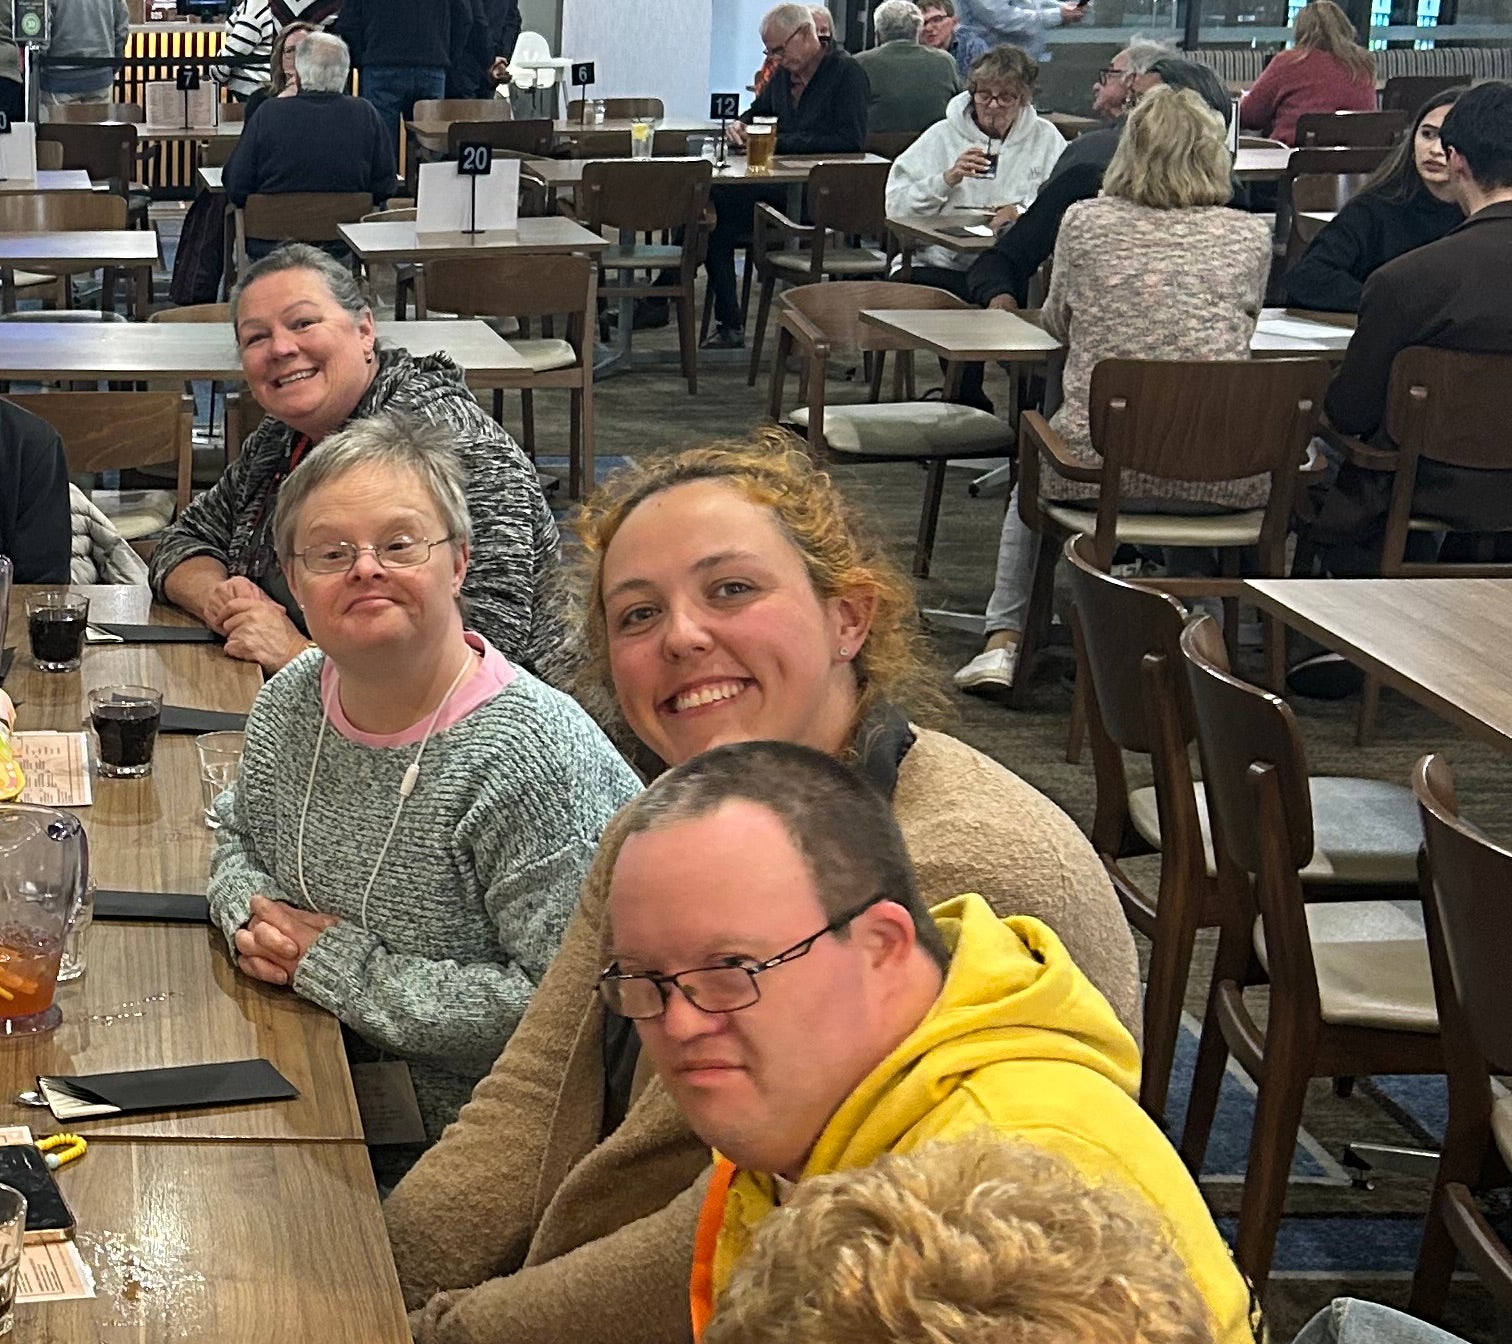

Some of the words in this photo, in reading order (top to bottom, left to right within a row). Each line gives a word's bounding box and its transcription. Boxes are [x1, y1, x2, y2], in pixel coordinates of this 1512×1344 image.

[183, 72, 193, 87] 7
[578, 65, 588, 83] 6
[715, 97, 736, 117] 12
[462, 145, 488, 171] 20
